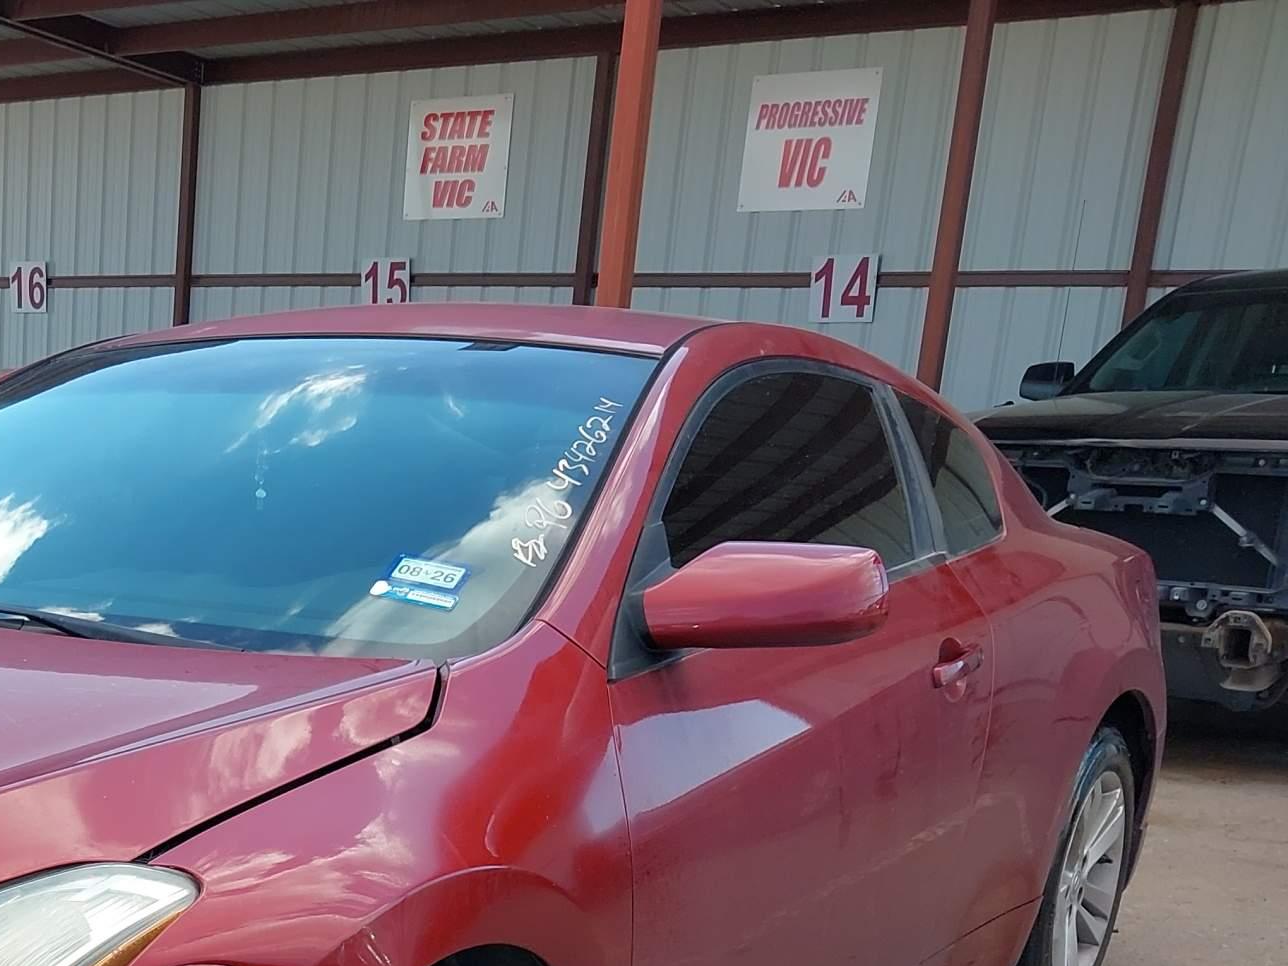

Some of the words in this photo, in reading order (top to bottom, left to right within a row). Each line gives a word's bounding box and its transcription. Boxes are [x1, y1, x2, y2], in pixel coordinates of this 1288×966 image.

[420, 109, 496, 142] STATE
[755, 98, 870, 131] PROGRESSIVE
[419, 143, 490, 175] FARM
[778, 136, 832, 189] VIC
[432, 179, 476, 209] VIC
[11, 266, 45, 310] 16
[364, 261, 408, 304] 15
[814, 256, 872, 319] 14
[546, 396, 624, 491] 43426214
[397, 563, 424, 578] 08
[430, 569, 458, 585] 26
